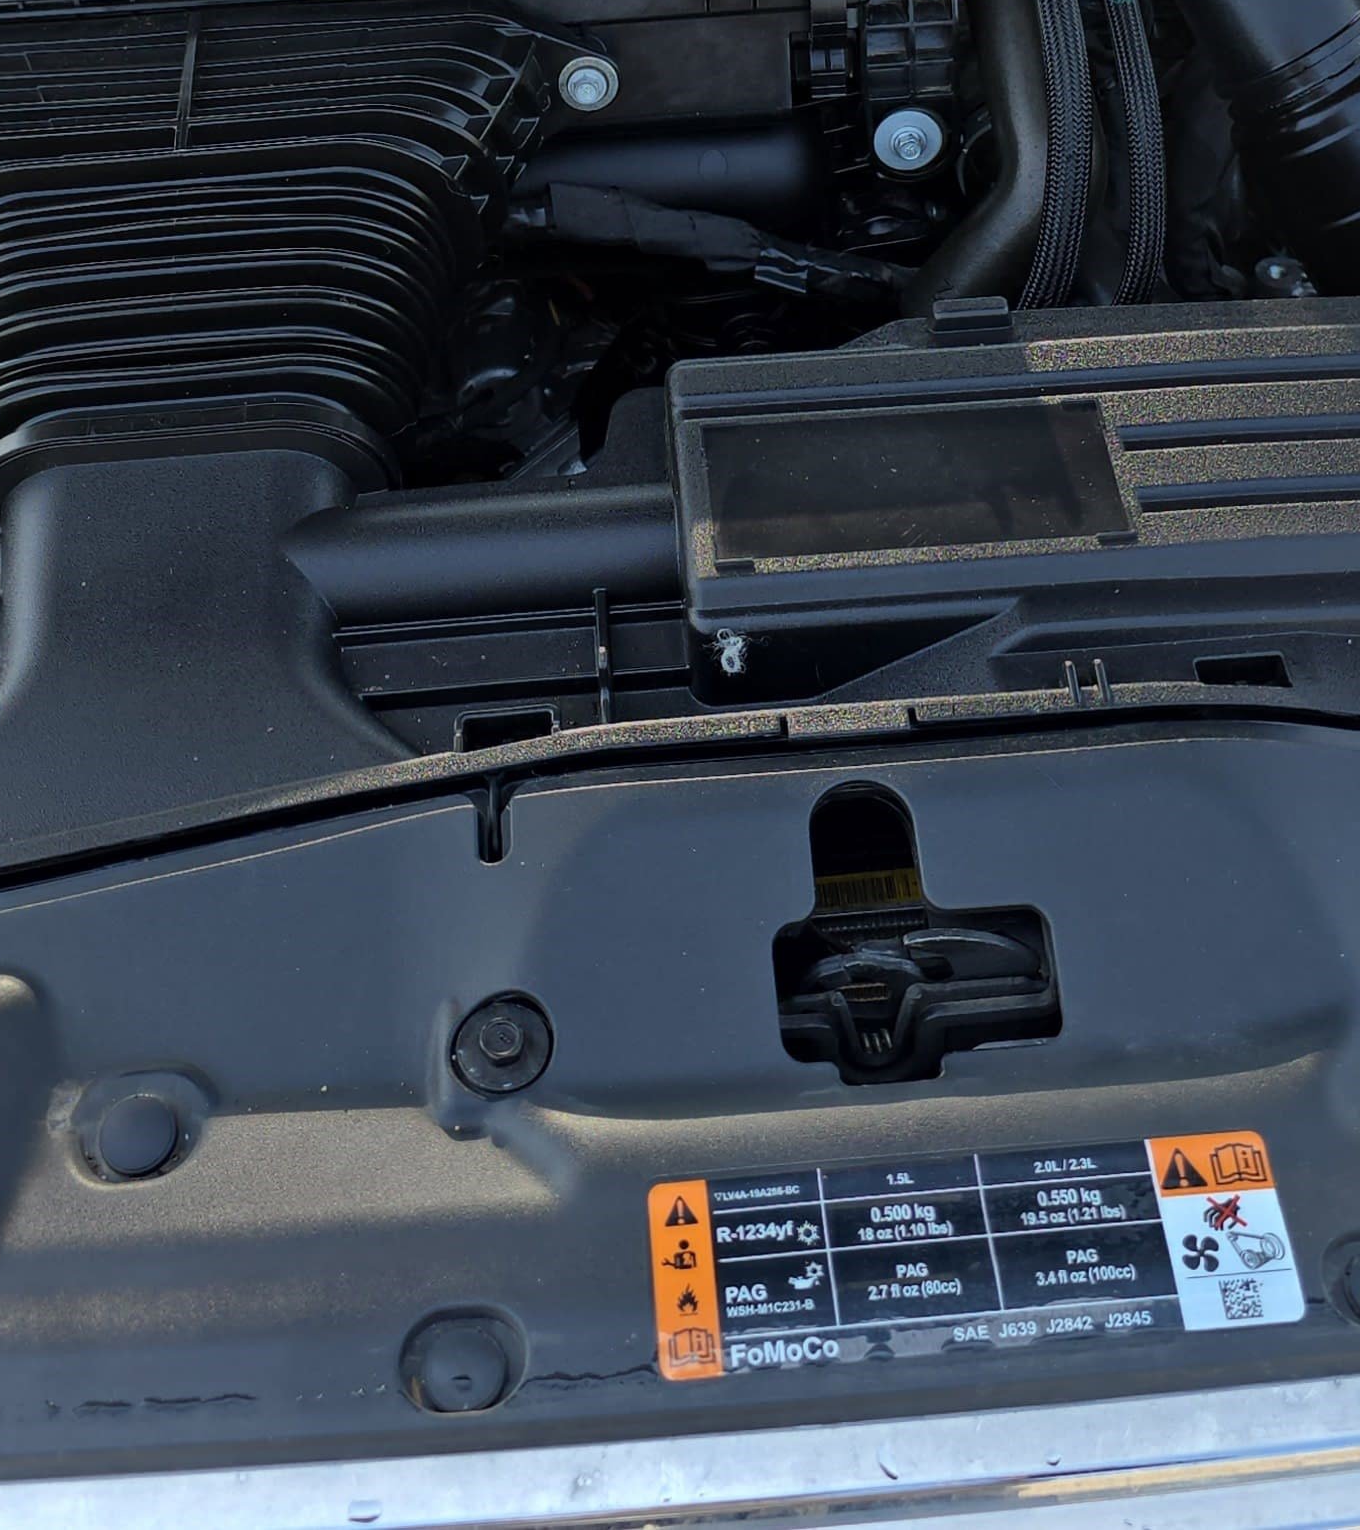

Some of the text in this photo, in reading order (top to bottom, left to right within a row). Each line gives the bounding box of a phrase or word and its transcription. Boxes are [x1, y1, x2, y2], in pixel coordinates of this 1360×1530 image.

[1034, 1160, 1061, 1173] 2.0L
[1069, 1157, 1097, 1170] 2.3L
[886, 1173, 915, 1185] 1.5L
[1037, 1187, 1101, 1207] 0.550 kg
[871, 1203, 935, 1223] 0.500 kg
[1020, 1204, 1126, 1226] 19.5 oz (1.21 lbs)
[717, 1220, 794, 1243] R-1234yf
[858, 1220, 954, 1241] 18 oz (1.10 lbs)
[1066, 1248, 1099, 1264] PAG
[896, 1262, 929, 1278] PAG
[1036, 1264, 1136, 1286] 3.4 fl oz (100cc)
[725, 1284, 768, 1303] PAG
[868, 1278, 962, 1301] 2.7 fl oz (80cc)
[726, 1298, 815, 1318] WSH-M1C231-B
[953, 1310, 1152, 1342] SAE J639 J2842 J2845
[730, 1336, 839, 1368] FoMoCo
